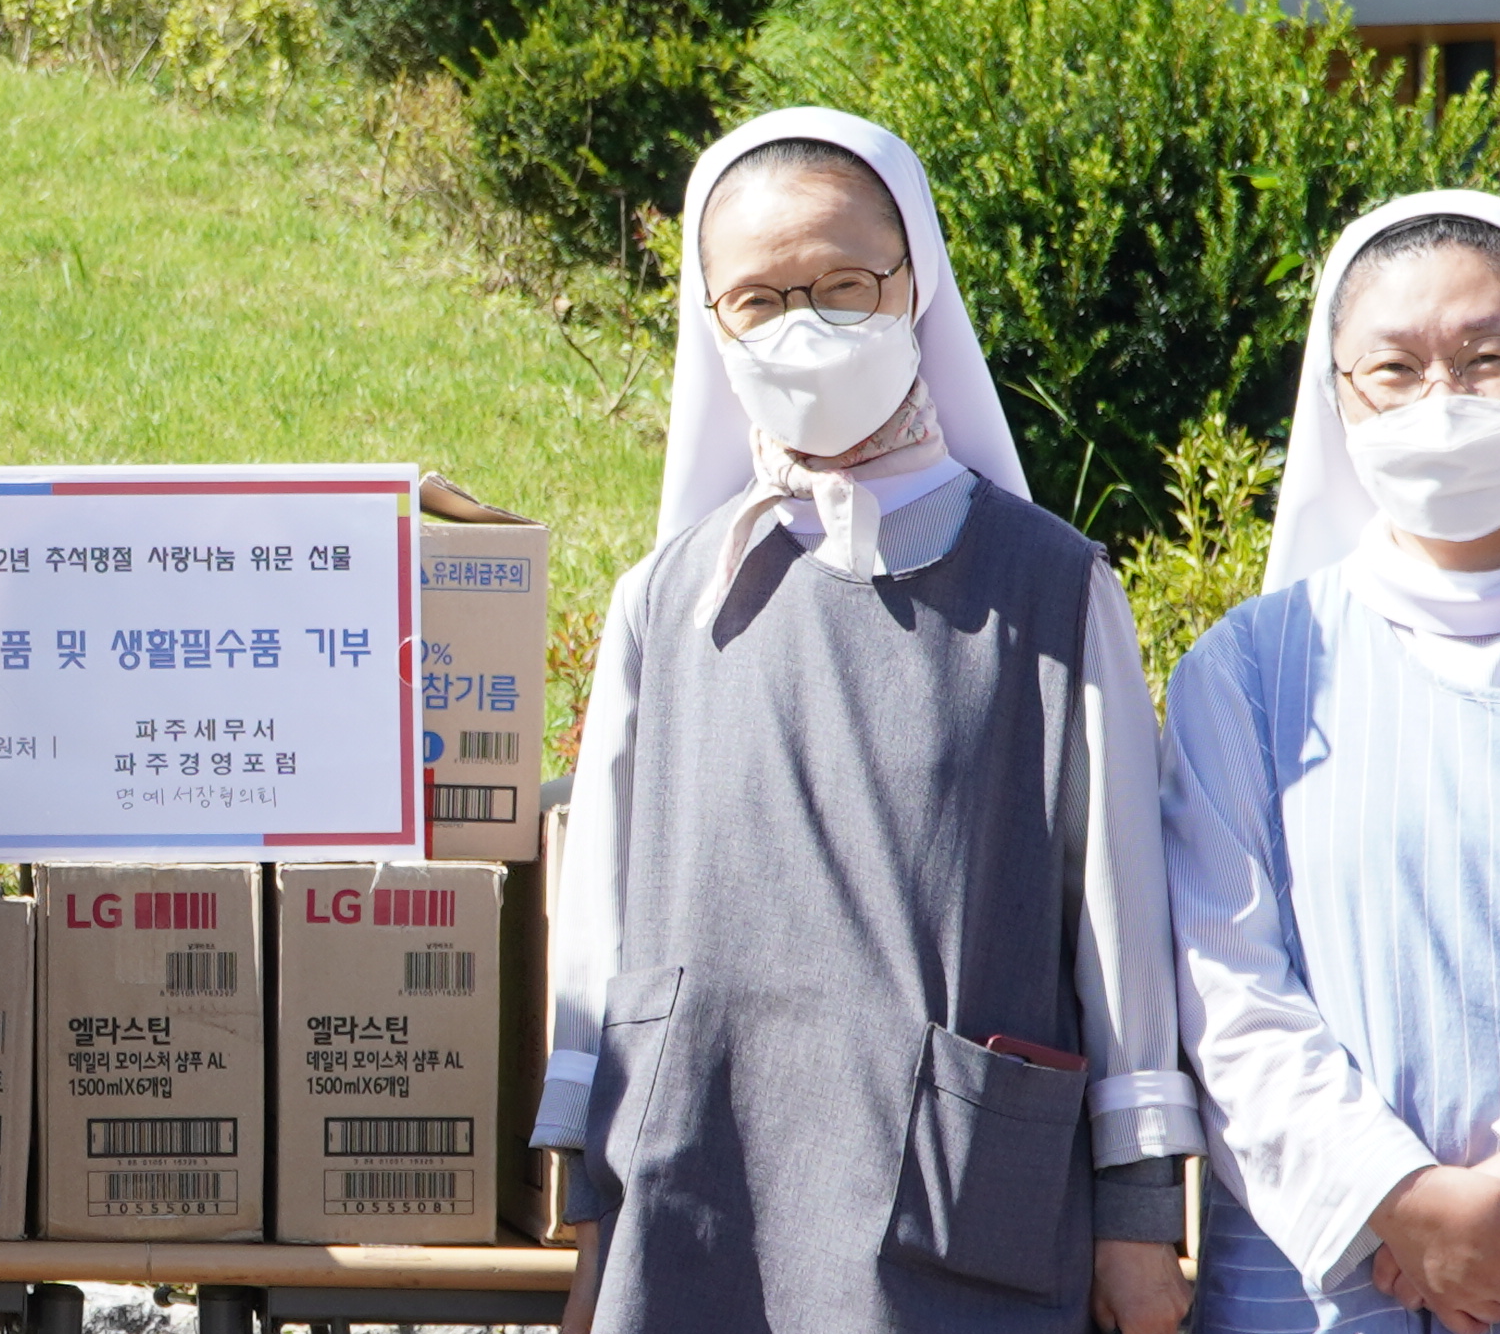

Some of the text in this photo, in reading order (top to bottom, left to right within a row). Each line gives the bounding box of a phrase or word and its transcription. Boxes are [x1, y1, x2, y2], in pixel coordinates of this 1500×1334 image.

[44, 546, 133, 573] 추석명절
[147, 545, 236, 573] 사랑나눔
[249, 544, 294, 572] 위문
[307, 544, 352, 572] 선물
[432, 561, 524, 588] 유리취급주의
[55, 628, 87, 670] 및
[110, 628, 282, 670] 생활필수품
[304, 627, 373, 669] 기부
[134, 718, 277, 742] 파주세무서
[113, 751, 298, 776] 파주경영포럼
[66, 892, 123, 929] LG
[305, 888, 362, 925] LG
[68, 1015, 172, 1047] 엘라스틴
[306, 1015, 409, 1046] 엘라스틴
[68, 1051, 228, 1074] 데일리 모이스처 샴푸 AL
[306, 1050, 465, 1073] 데일리 모이스처 샴푸 AL
[104, 1203, 221, 1215] 10555081
[341, 1202, 457, 1214] 10555081
